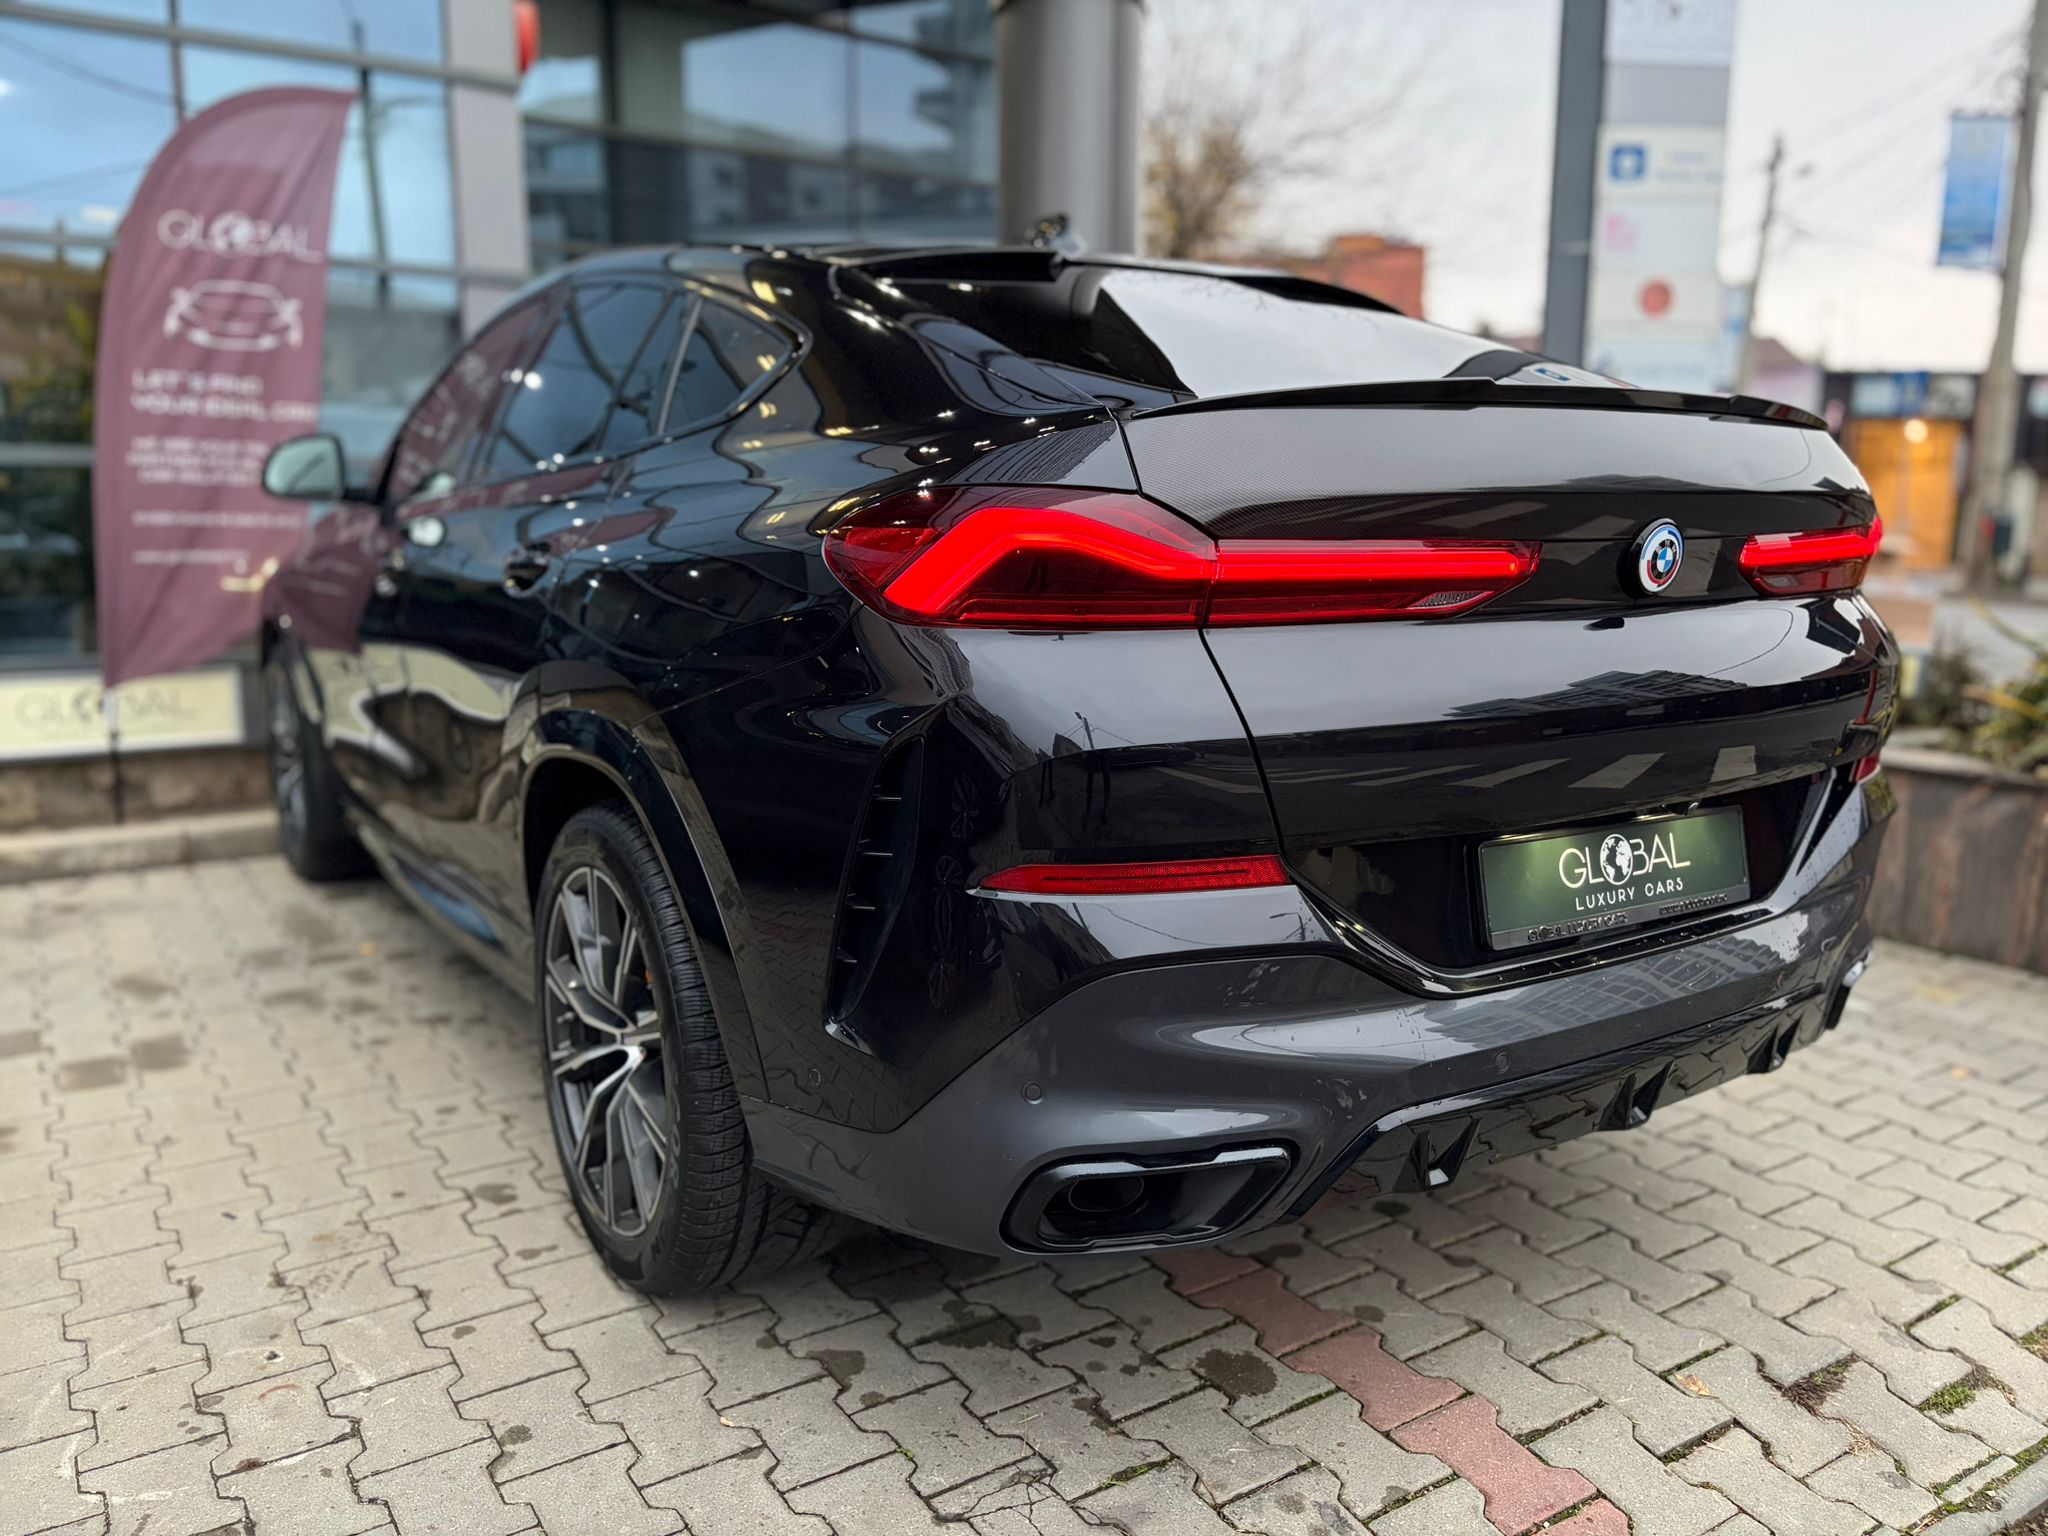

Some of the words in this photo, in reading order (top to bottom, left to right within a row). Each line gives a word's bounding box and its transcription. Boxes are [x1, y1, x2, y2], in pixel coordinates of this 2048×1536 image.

[157, 209, 324, 264] GLOBAL
[1559, 832, 1690, 888] GLOBAL
[1576, 887, 1635, 911] LUXURY
[1644, 877, 1684, 897] CARS
